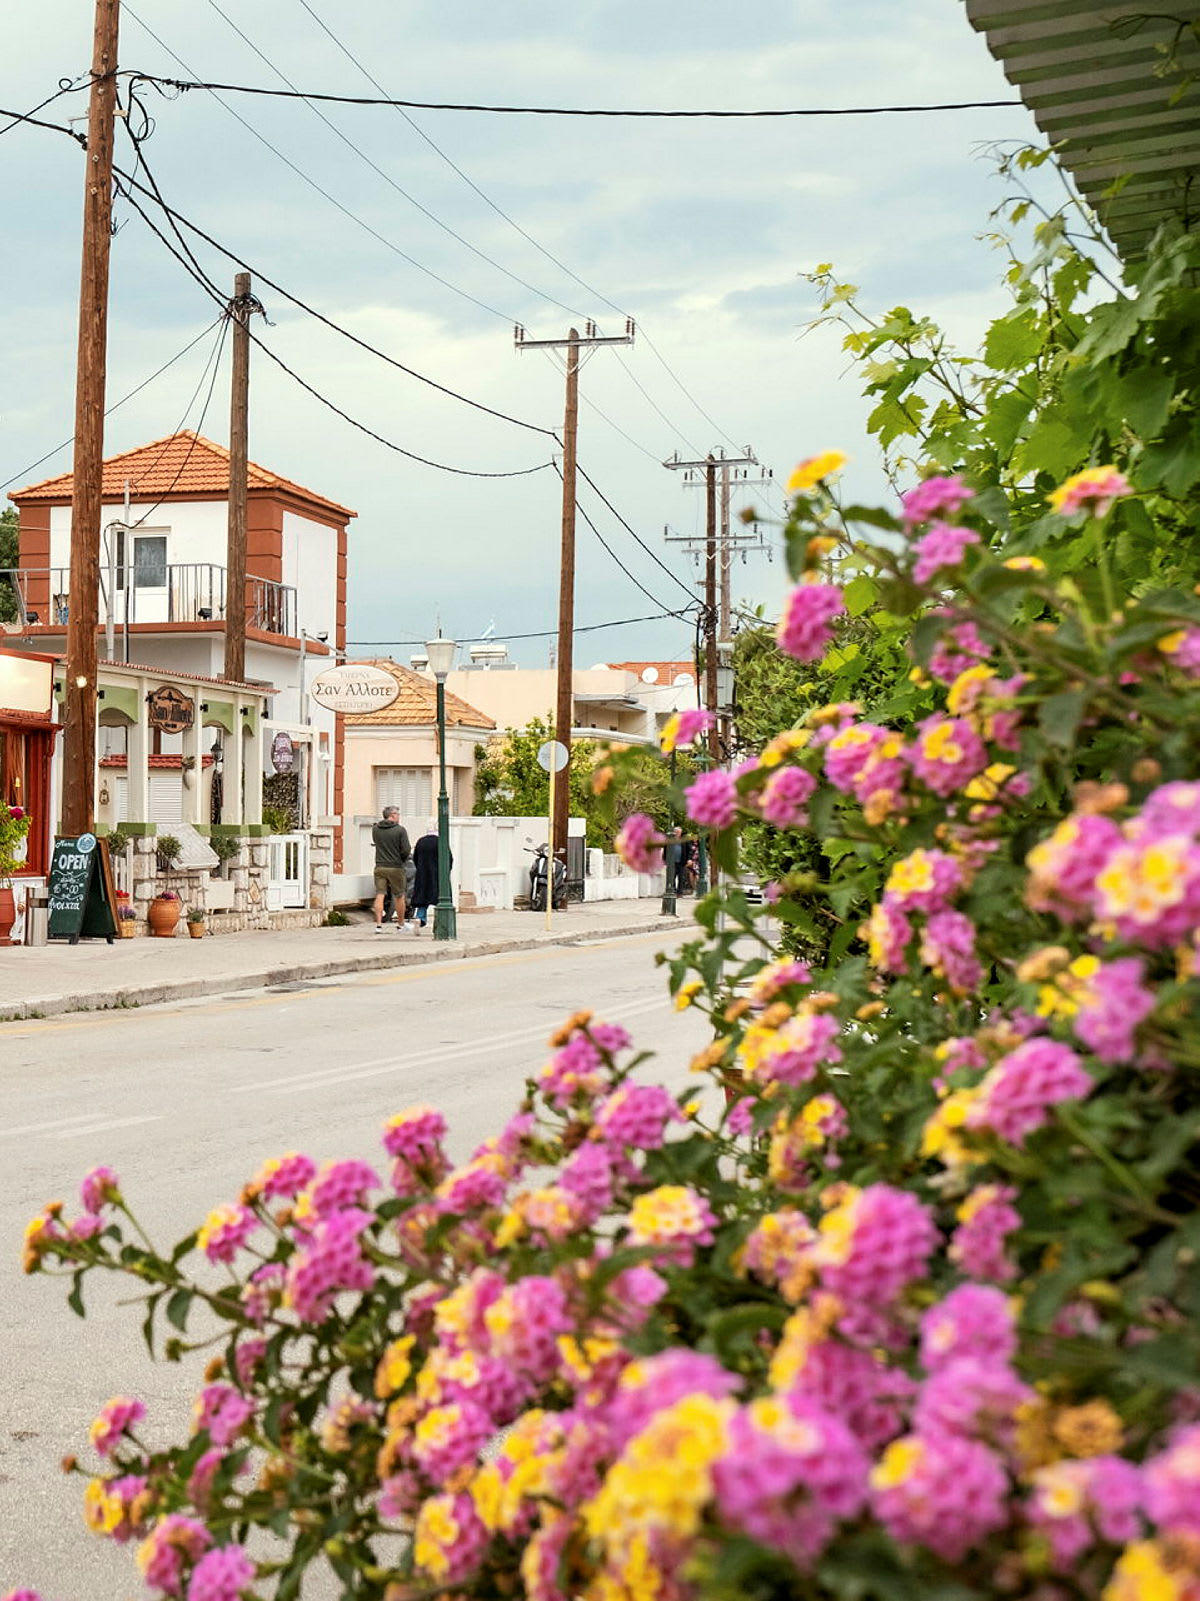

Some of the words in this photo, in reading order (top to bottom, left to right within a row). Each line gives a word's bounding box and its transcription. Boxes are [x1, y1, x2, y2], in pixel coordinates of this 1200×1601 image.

[316, 682, 341, 696] Σαν
[346, 682, 393, 697] Άλλοτε
[58, 854, 89, 870] OPEN
